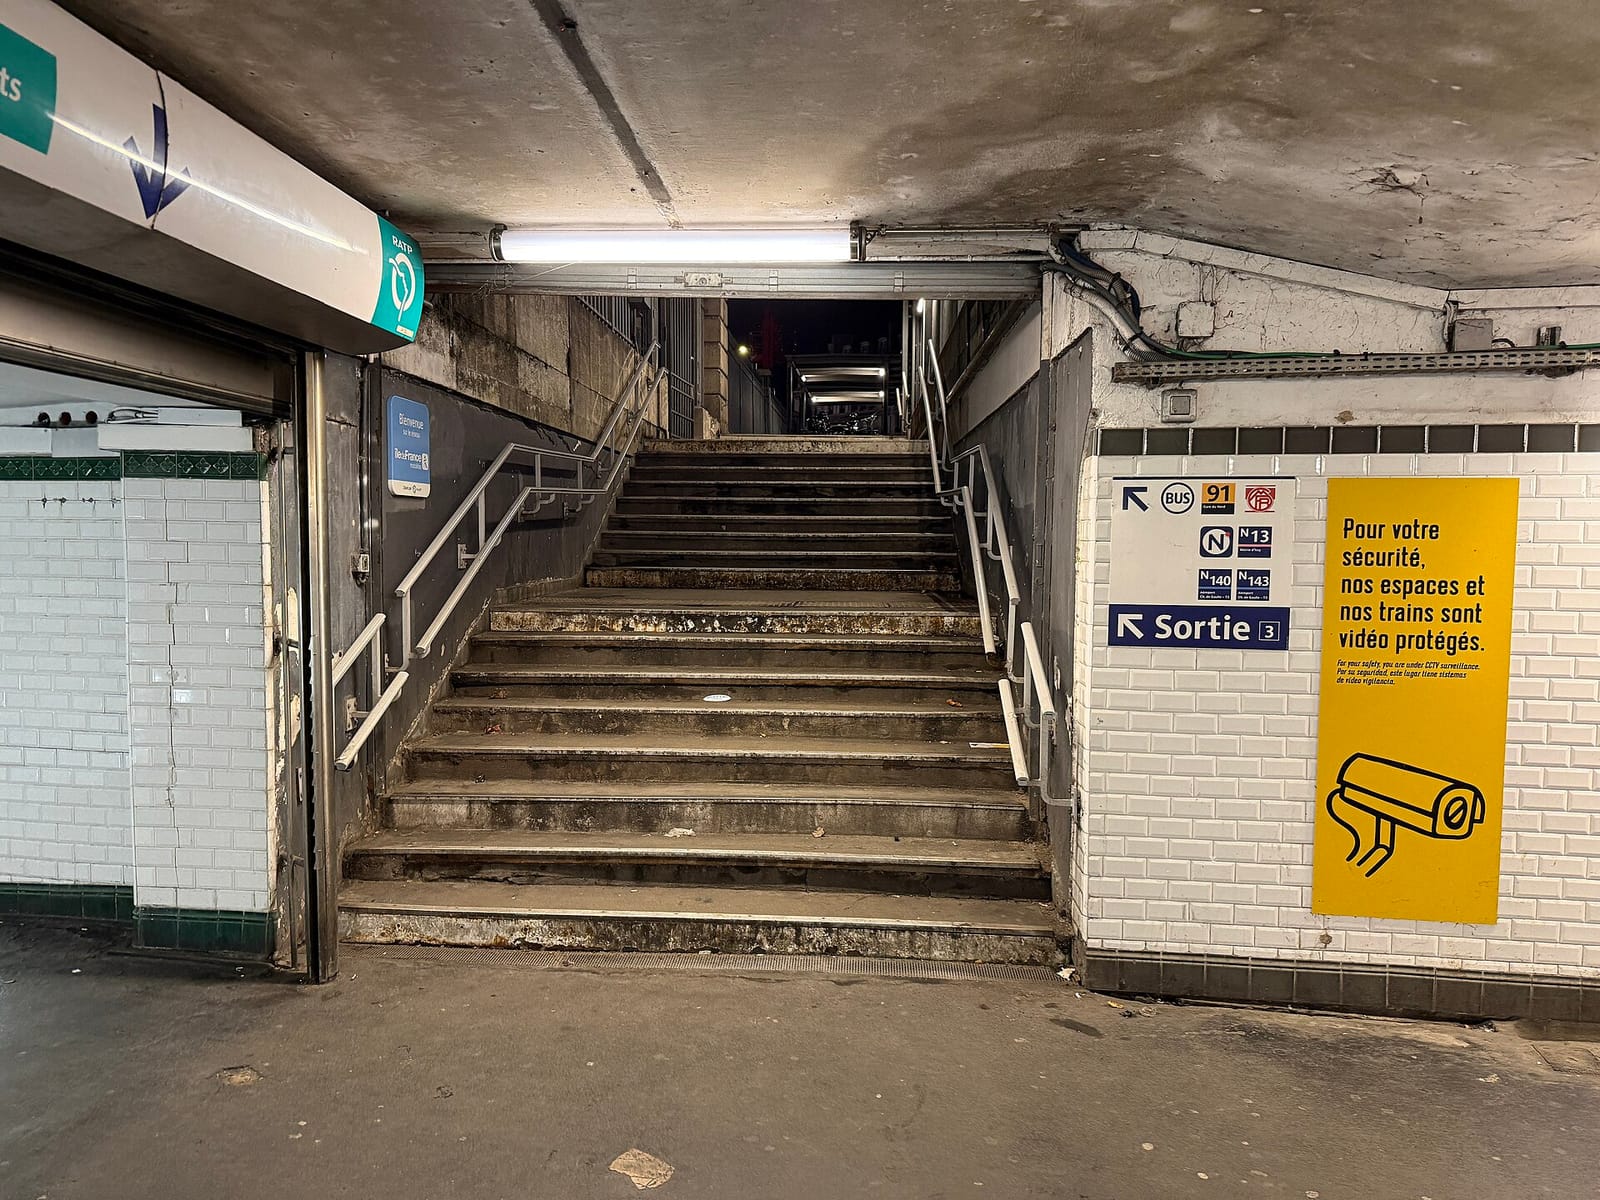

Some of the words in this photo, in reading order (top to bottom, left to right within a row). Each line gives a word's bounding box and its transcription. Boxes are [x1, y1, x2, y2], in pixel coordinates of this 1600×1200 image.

[392, 235, 413, 254] RATP
[399, 413, 424, 430] Bienvenue
[1165, 492, 1190, 505] BUS
[1207, 484, 1230, 502] 91
[1343, 518, 1386, 539] Pour
[1392, 519, 1440, 539] votre
[1208, 534, 1224, 550] N
[1342, 546, 1426, 569] sécurité,
[1341, 578, 1373, 594] nos
[1380, 578, 1459, 600] espaces
[1466, 575, 1485, 595] et
[1340, 605, 1372, 621] nos
[1379, 601, 1434, 622] trains
[1441, 603, 1482, 623] sont
[1155, 614, 1250, 641] Sortie
[1264, 625, 1274, 638] 3
[1339, 628, 1389, 649] vidéo
[1395, 629, 1485, 656] protégés.
[1337, 659, 1346, 667] For
[1337, 667, 1347, 675] Por
[1404, 670, 1421, 678] lugar
